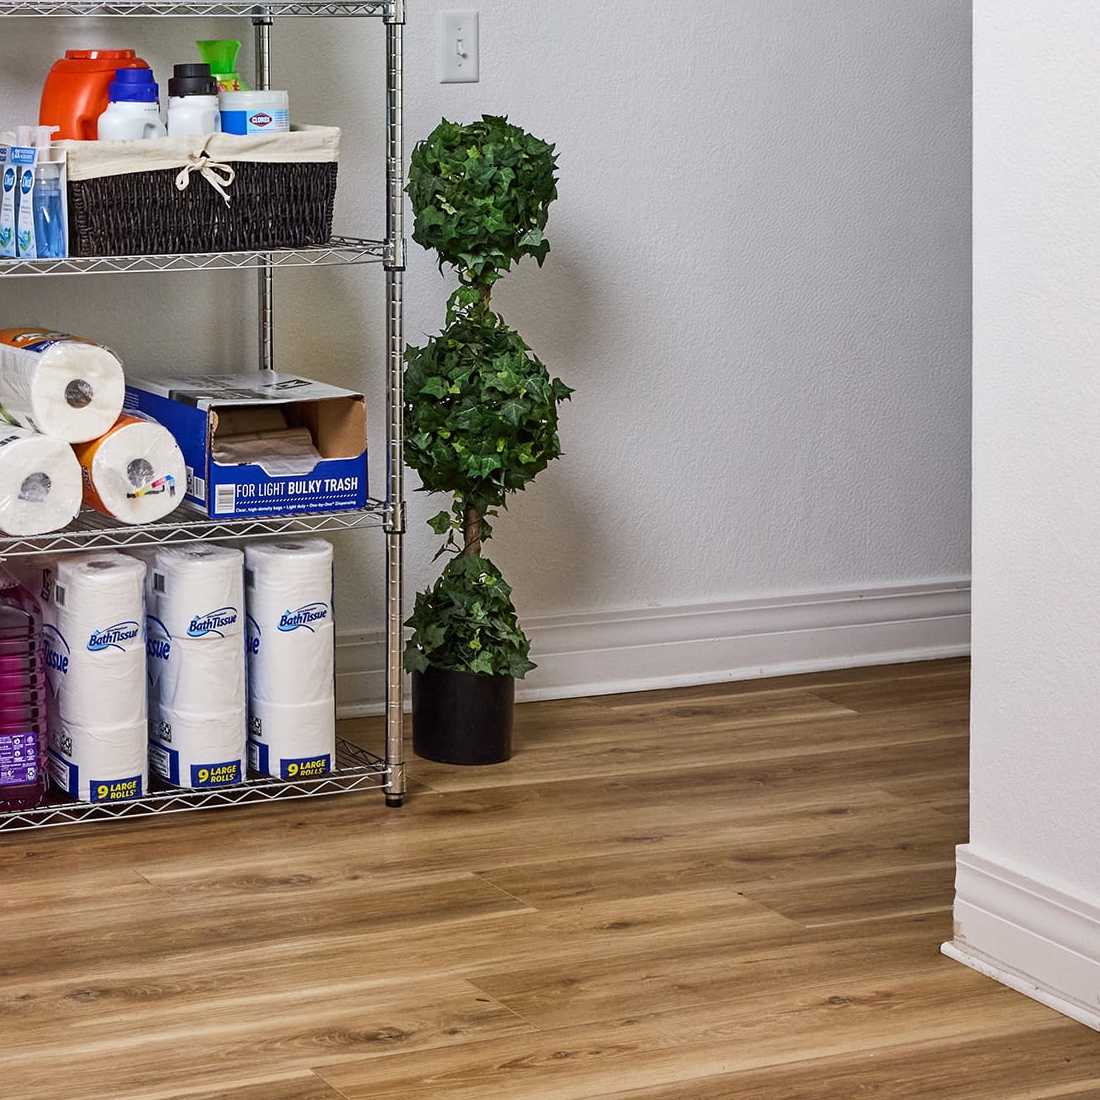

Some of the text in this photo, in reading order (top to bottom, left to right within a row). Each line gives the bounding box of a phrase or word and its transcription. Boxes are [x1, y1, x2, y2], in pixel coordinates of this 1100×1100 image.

[236, 477, 358, 498] FOR LIGHT BULKY TRASH
[43, 639, 69, 674] Tissue
[198, 765, 237, 783] 9 LARGE
[287, 759, 326, 777] 9 LARGE
[300, 768, 323, 776] ROLLS
[210, 774, 234, 783] ROLLS
[97, 780, 137, 799] 9 LARGE
[110, 790, 134, 799] ROLLS
